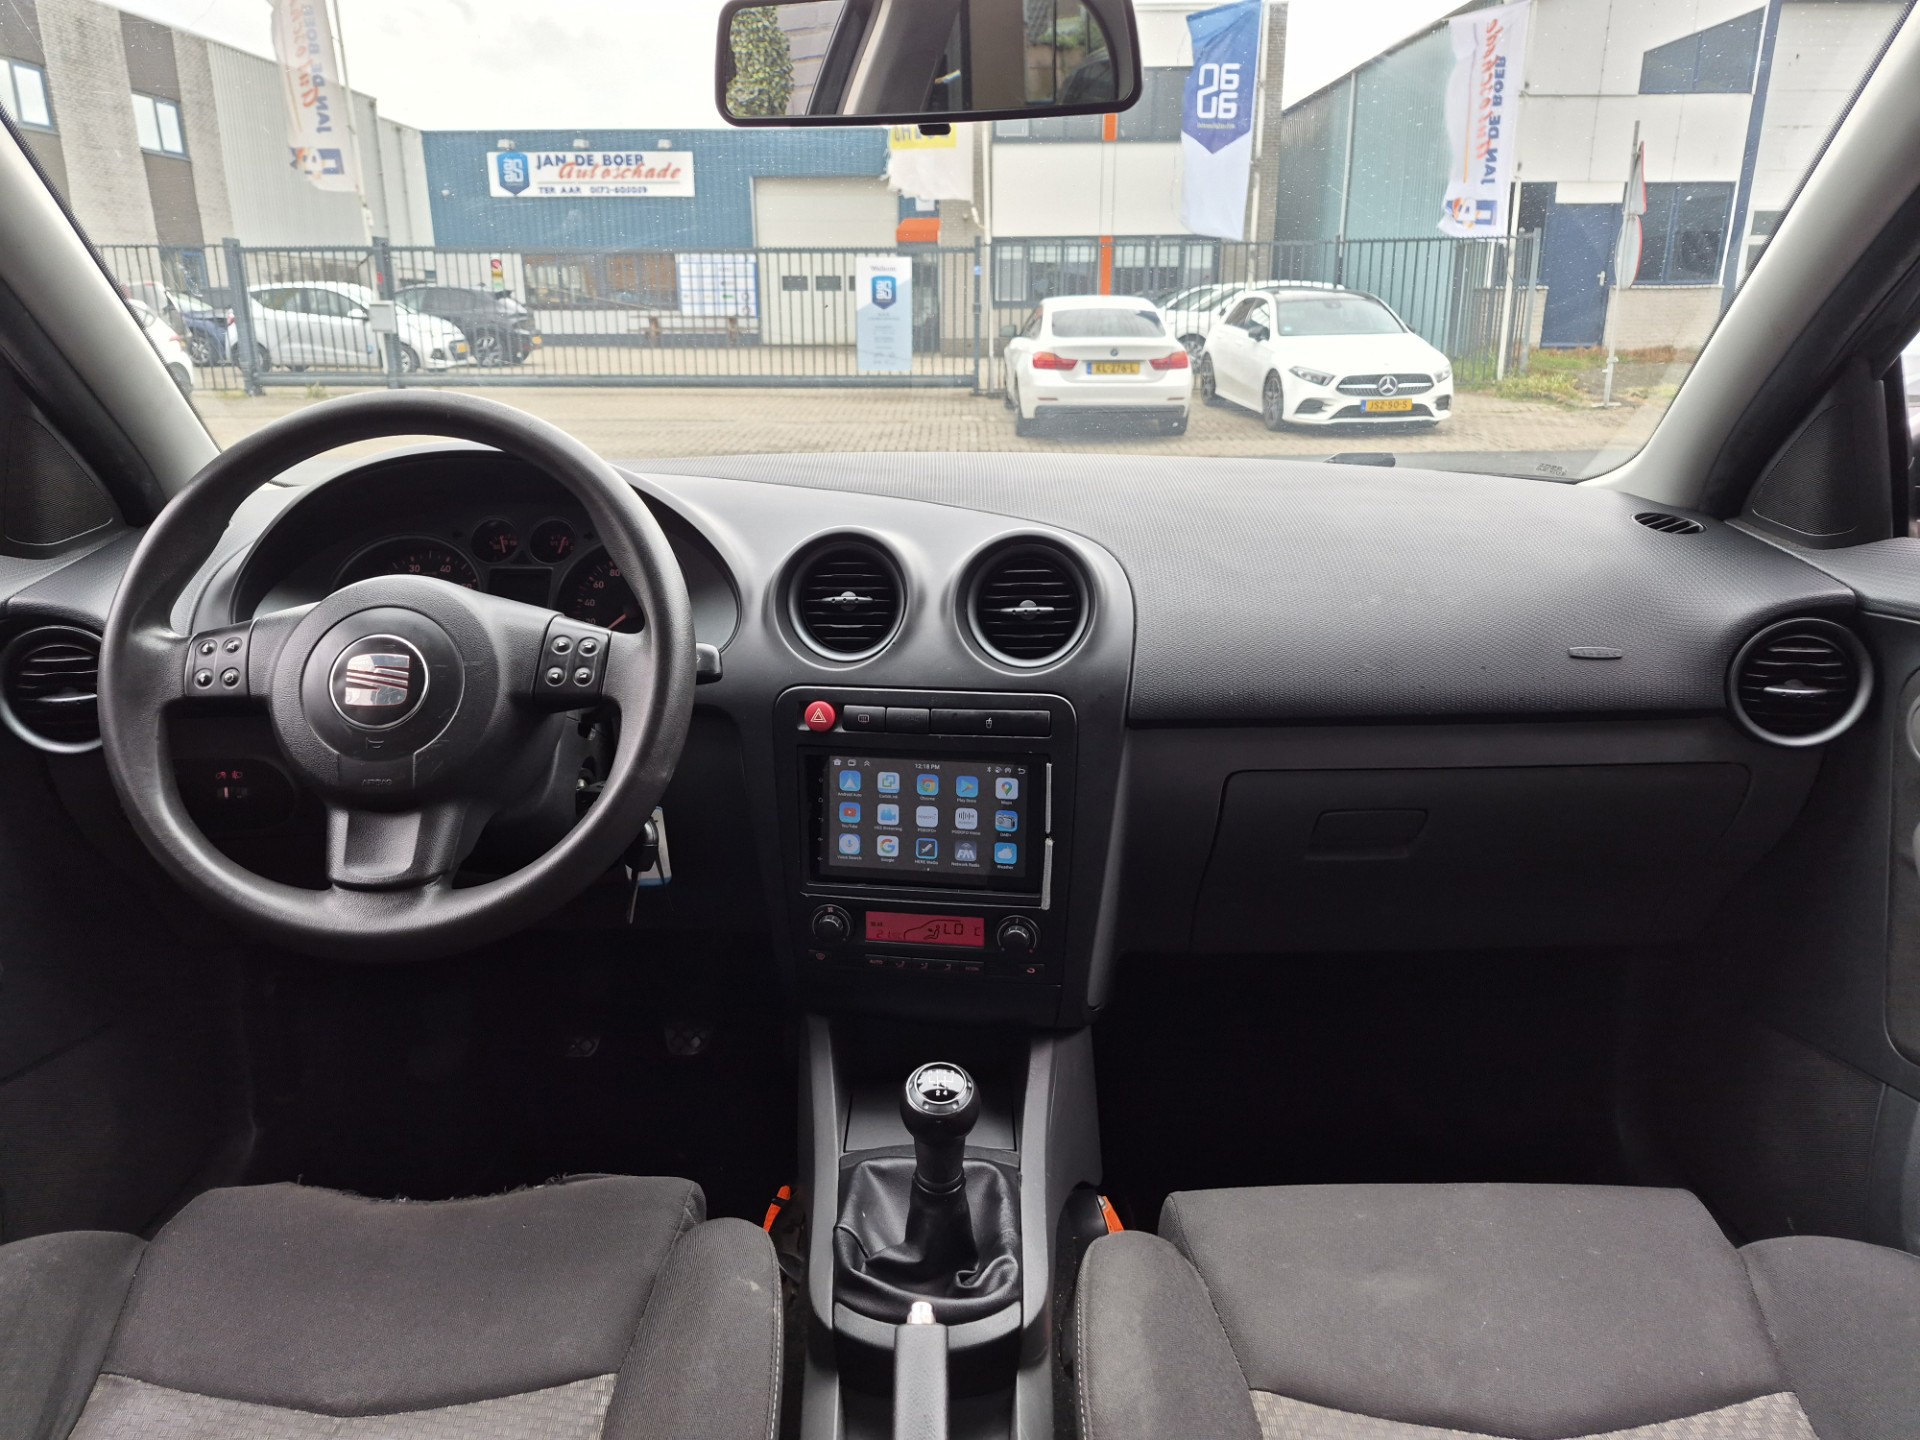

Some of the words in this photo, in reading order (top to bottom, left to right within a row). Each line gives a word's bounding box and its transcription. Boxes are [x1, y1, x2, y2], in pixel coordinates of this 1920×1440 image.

[537, 155, 566, 170] JAN
[574, 155, 595, 166] DE
[602, 155, 644, 167] BOER
[558, 162, 682, 180] Autoschade
[539, 186, 556, 194] TER
[560, 186, 582, 194] AAR
[408, 564, 421, 573] 30
[439, 564, 452, 573] 40
[609, 569, 621, 577] 80
[593, 580, 604, 589] 60
[584, 599, 596, 607] 40
[914, 762, 930, 770] 12:18
[957, 849, 975, 859] FM
